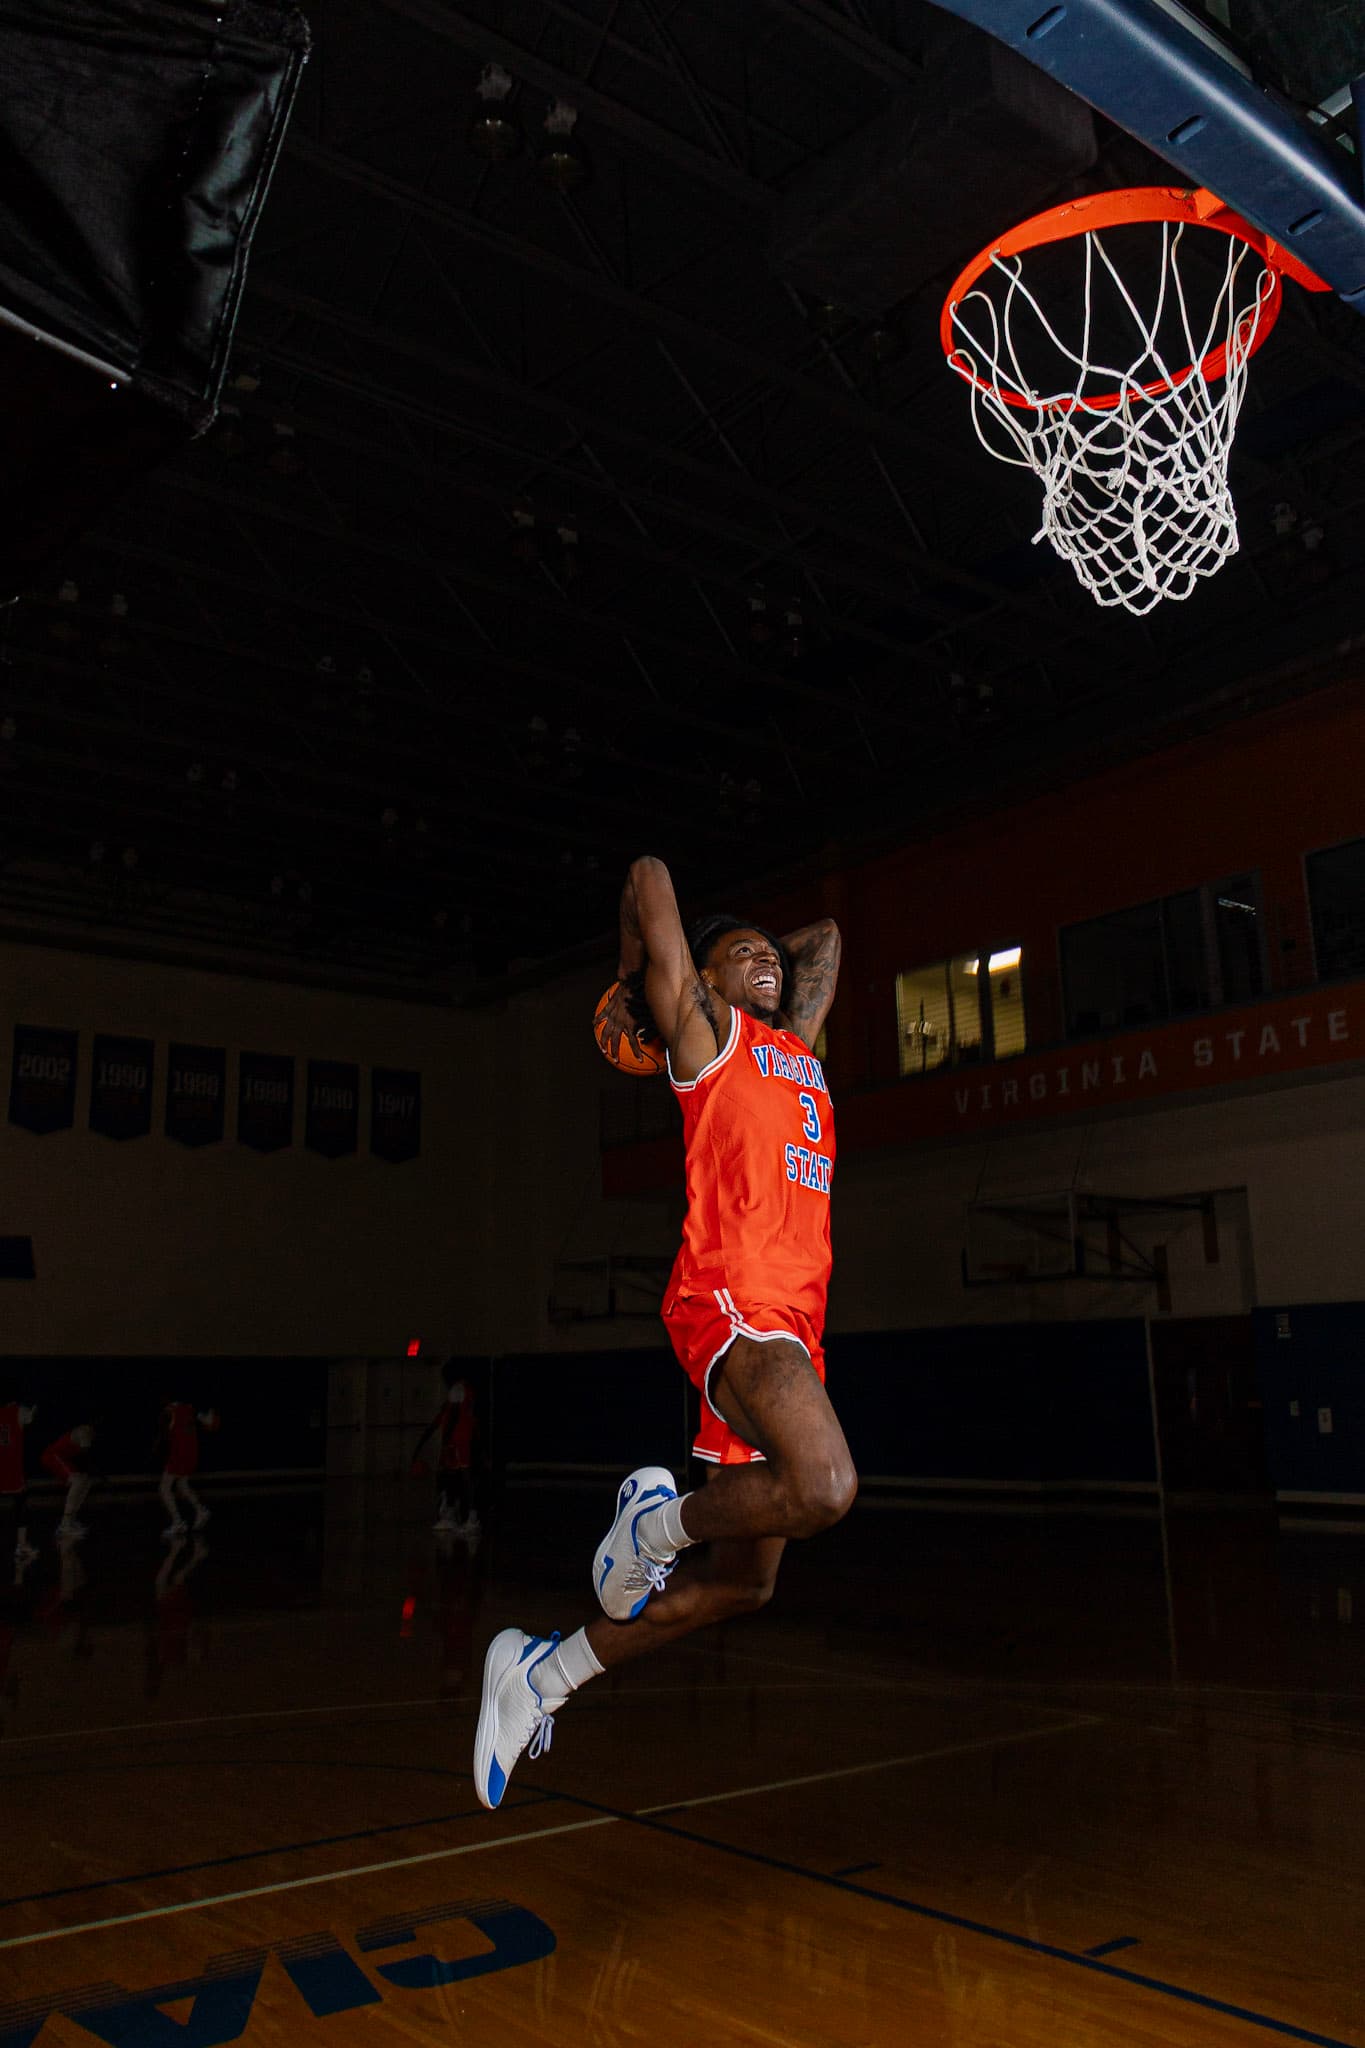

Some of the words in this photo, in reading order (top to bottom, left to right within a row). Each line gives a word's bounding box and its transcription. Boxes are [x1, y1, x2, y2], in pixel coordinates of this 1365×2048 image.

[17, 1053, 72, 1081] 2002
[752, 1043, 832, 1106] VIRGIN
[953, 1045, 1159, 1115] VIRGINIA
[1193, 1008, 1350, 1068] STATE
[799, 1092, 822, 1143] 3
[785, 1142, 832, 1200] STAT
[0, 1899, 557, 2048] CIA
